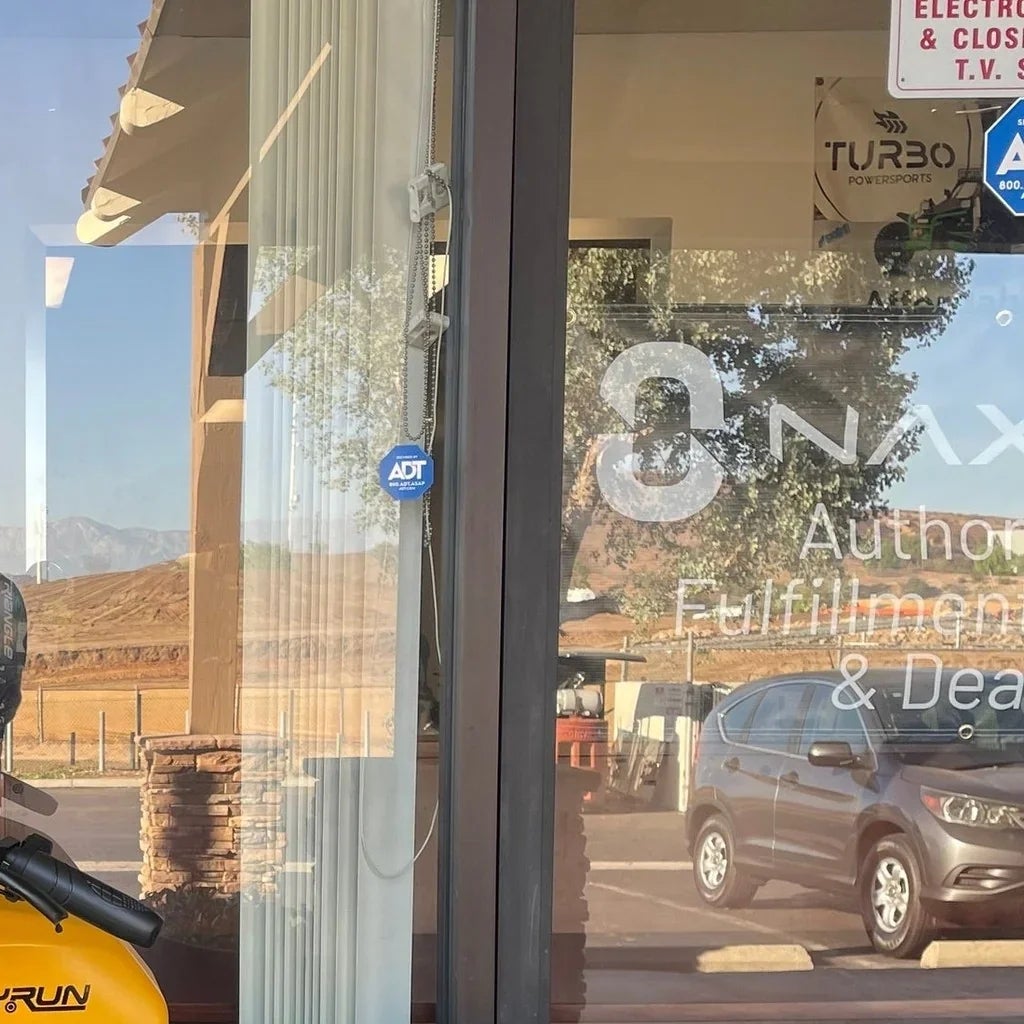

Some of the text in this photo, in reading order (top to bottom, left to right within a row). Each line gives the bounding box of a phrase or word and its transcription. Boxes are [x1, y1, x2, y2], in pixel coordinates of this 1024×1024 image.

[920, 28, 1024, 49] & CLOS
[955, 59, 1002, 80] T.V.
[824, 138, 956, 171] TURBO
[848, 174, 933, 186] POWERSPORTS
[388, 460, 428, 481] ADT
[675, 577, 1024, 636] Fulfillmen
[830, 652, 878, 711] &
